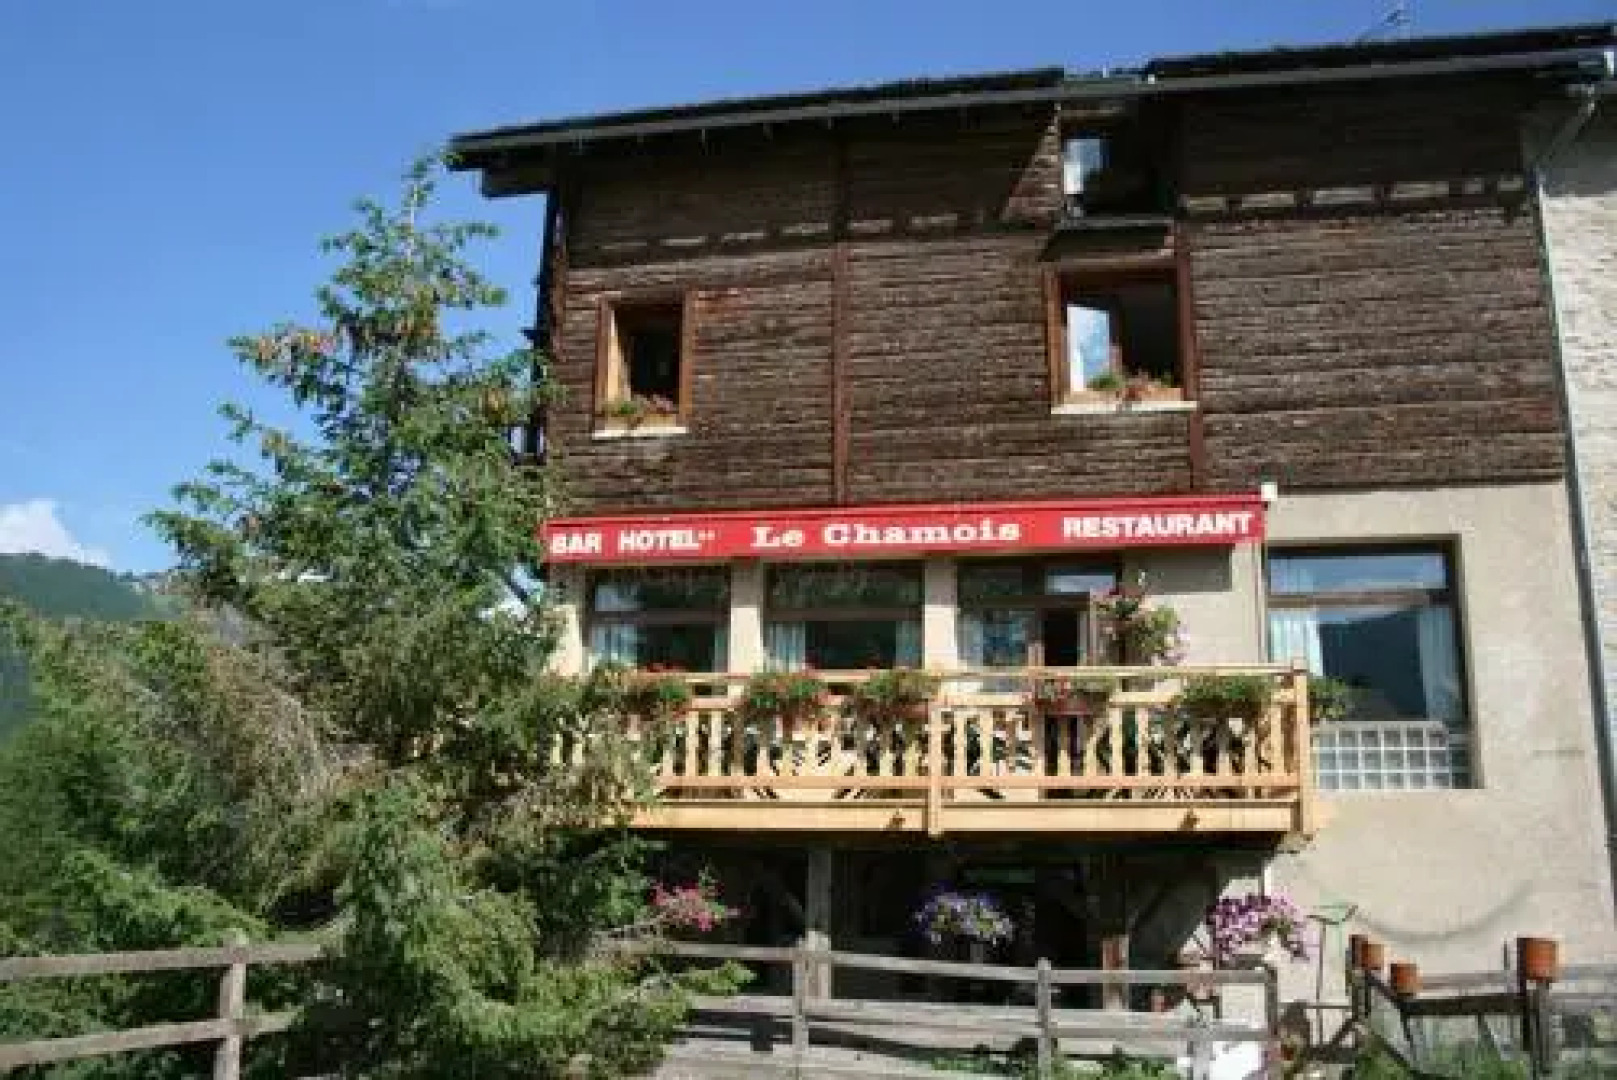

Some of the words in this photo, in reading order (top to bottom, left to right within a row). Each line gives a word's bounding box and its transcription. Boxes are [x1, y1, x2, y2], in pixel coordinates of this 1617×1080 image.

[551, 532, 602, 554] BAR
[750, 525, 804, 548] Le
[823, 517, 1022, 545] Chamois
[1062, 511, 1254, 538] RESTAURANT
